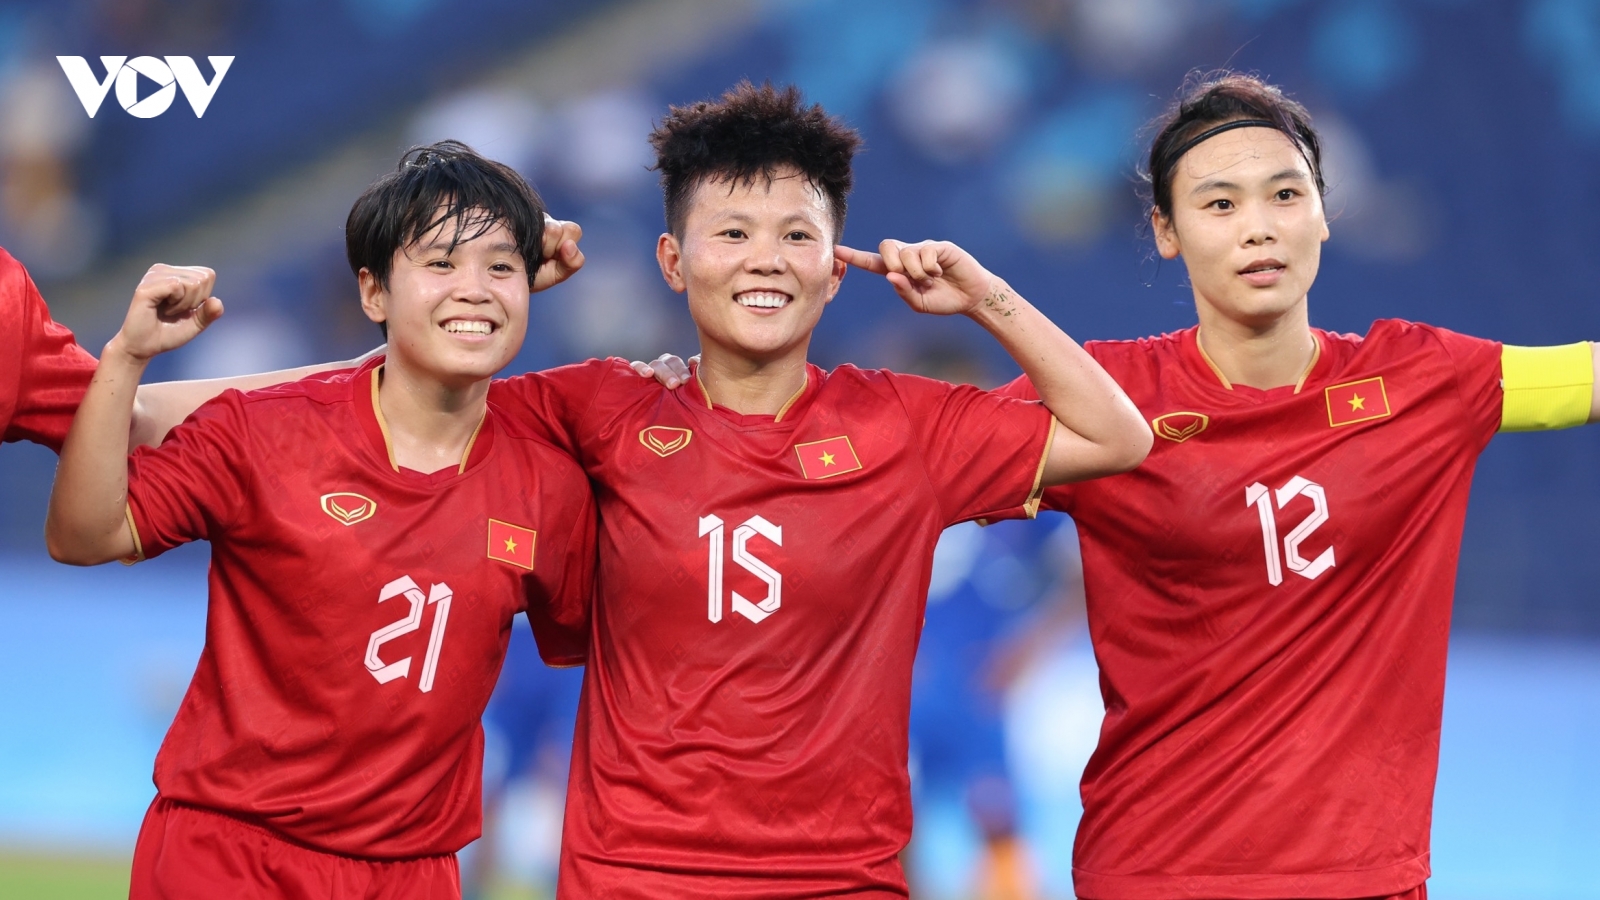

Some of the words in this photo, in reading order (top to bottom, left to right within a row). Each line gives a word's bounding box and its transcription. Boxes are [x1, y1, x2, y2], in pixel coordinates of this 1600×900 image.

[698, 513, 783, 624] 15
[1245, 475, 1336, 587] 12
[364, 574, 453, 693] 21
